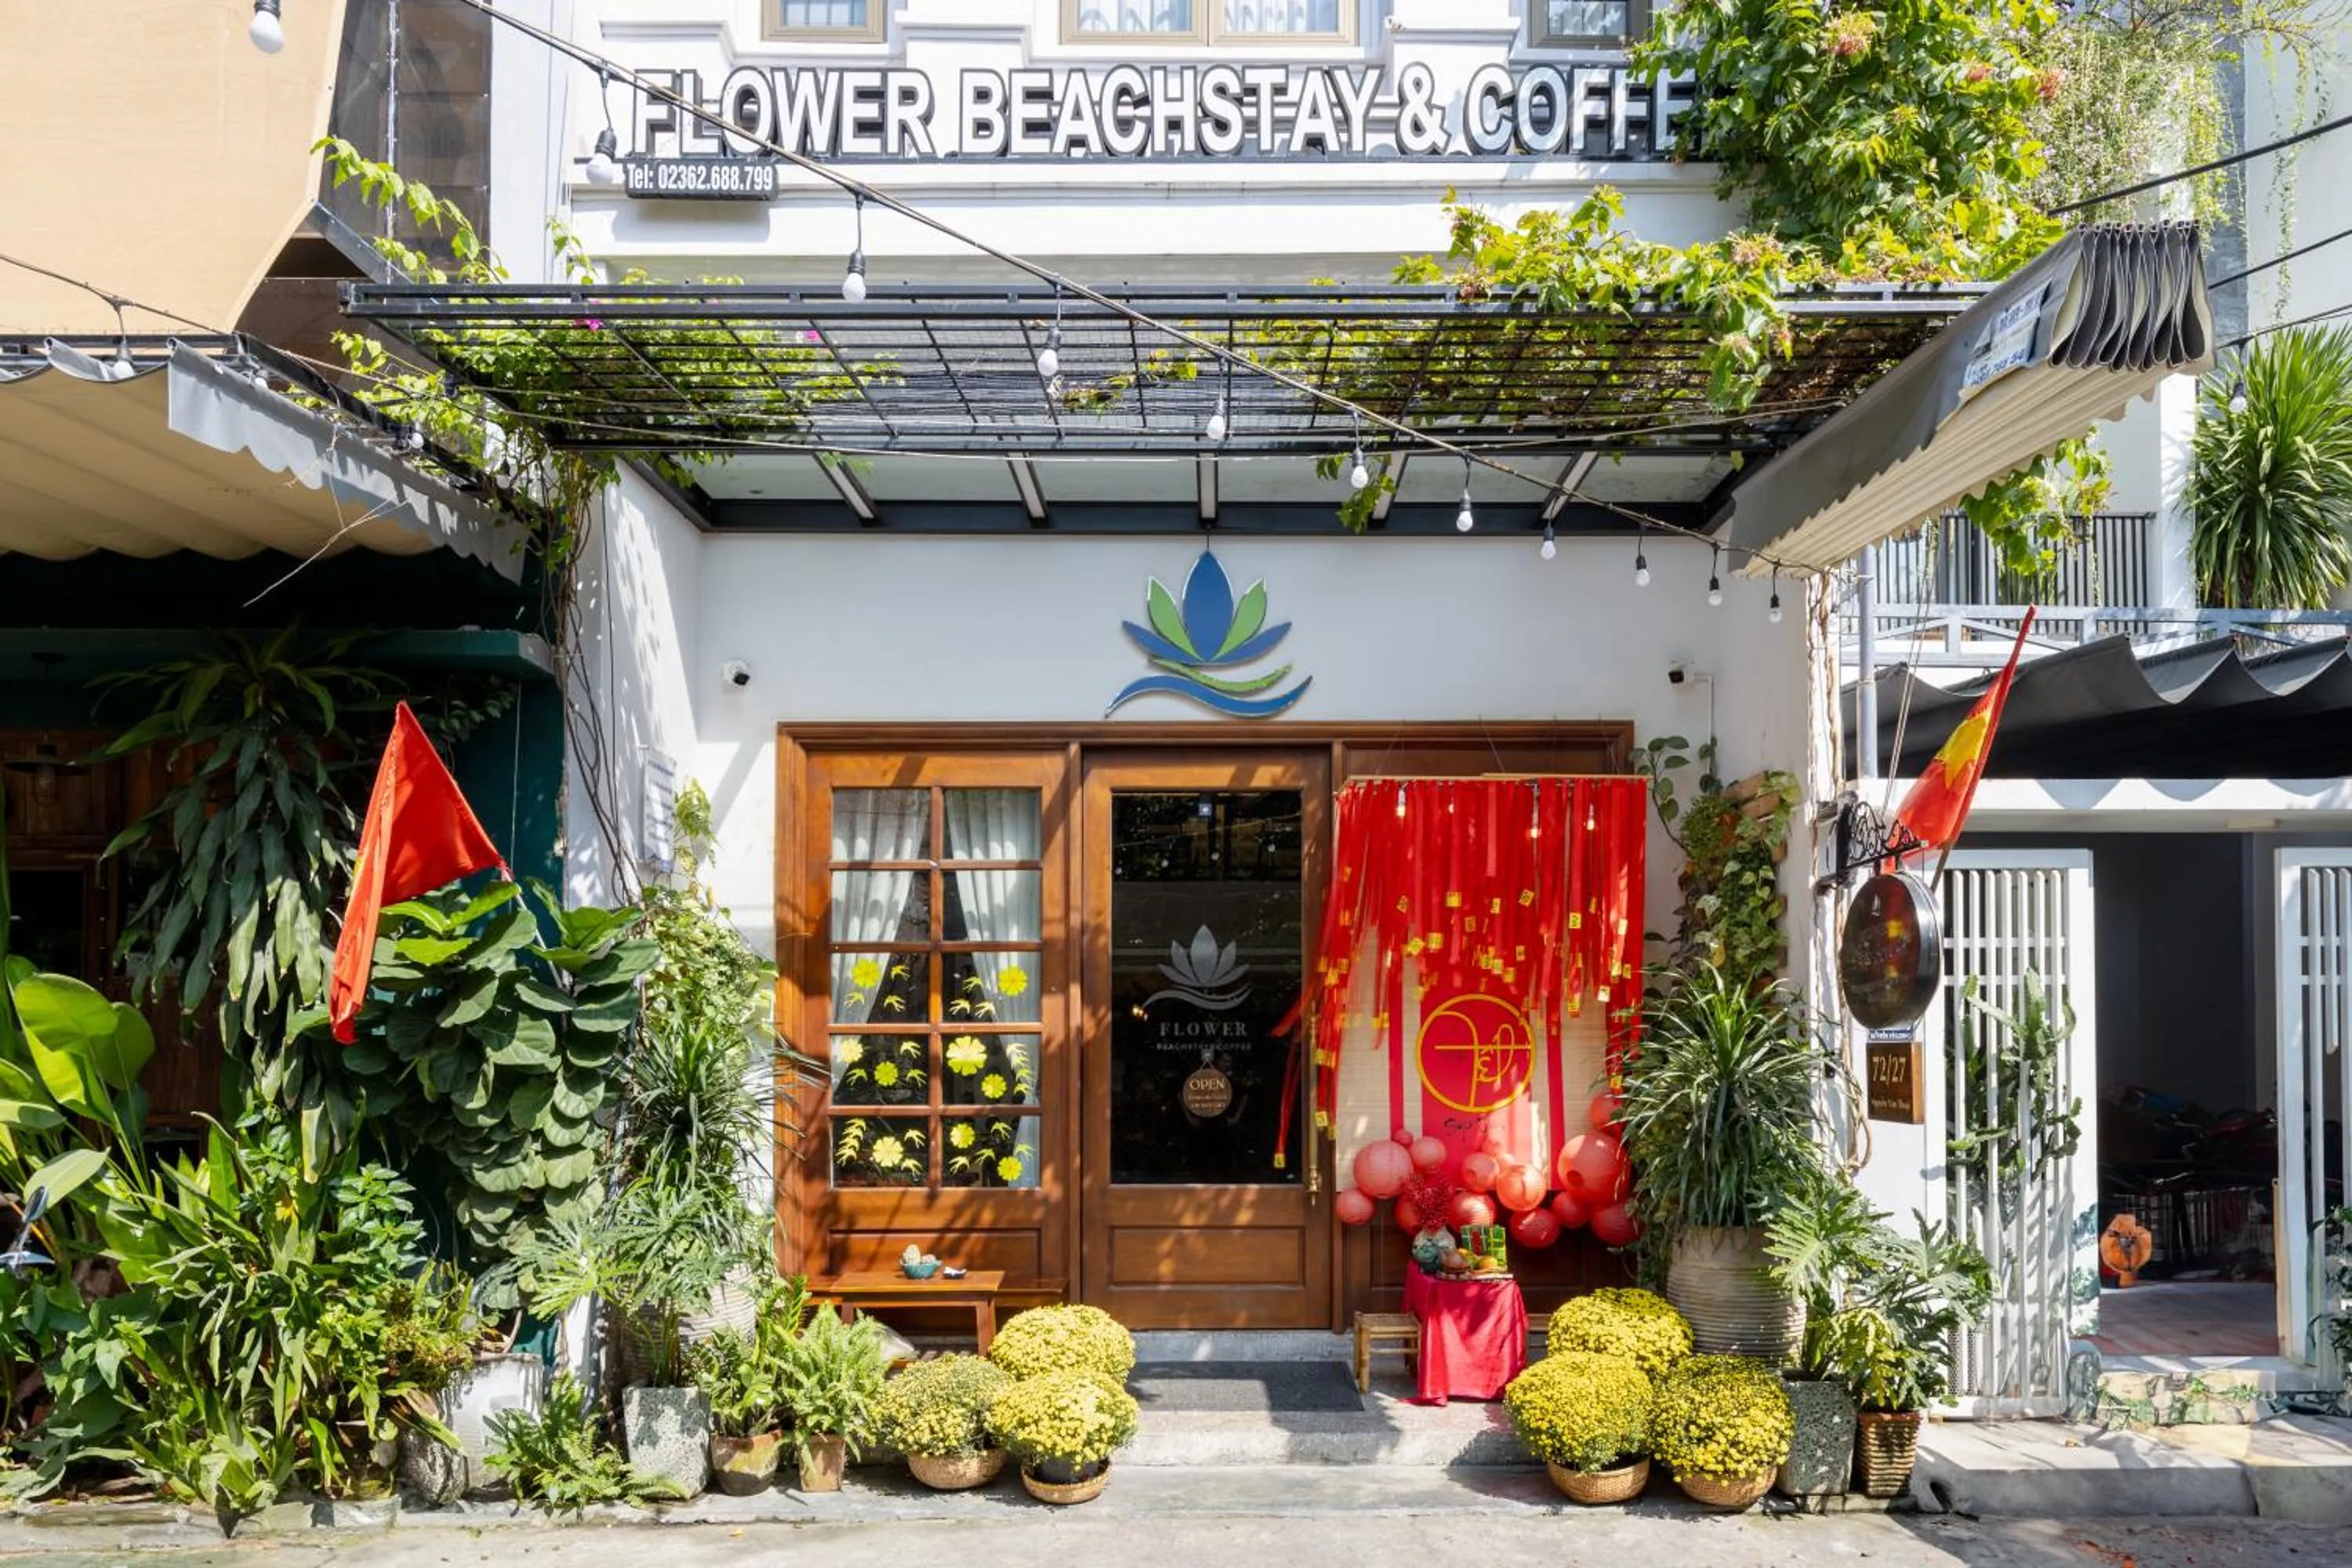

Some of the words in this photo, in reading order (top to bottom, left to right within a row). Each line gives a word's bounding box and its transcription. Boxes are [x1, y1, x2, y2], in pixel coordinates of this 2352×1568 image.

[632, 66, 938, 156] FLOWER
[958, 64, 1385, 157] BEACHSTAY
[1396, 61, 1451, 156] &
[627, 163, 653, 189] Tel:
[658, 164, 773, 191] 02362.688.799
[1160, 1022, 1248, 1036] FLOWER
[1871, 1053, 1906, 1086] 72/27
[1189, 1078, 1225, 1091] OPEN
